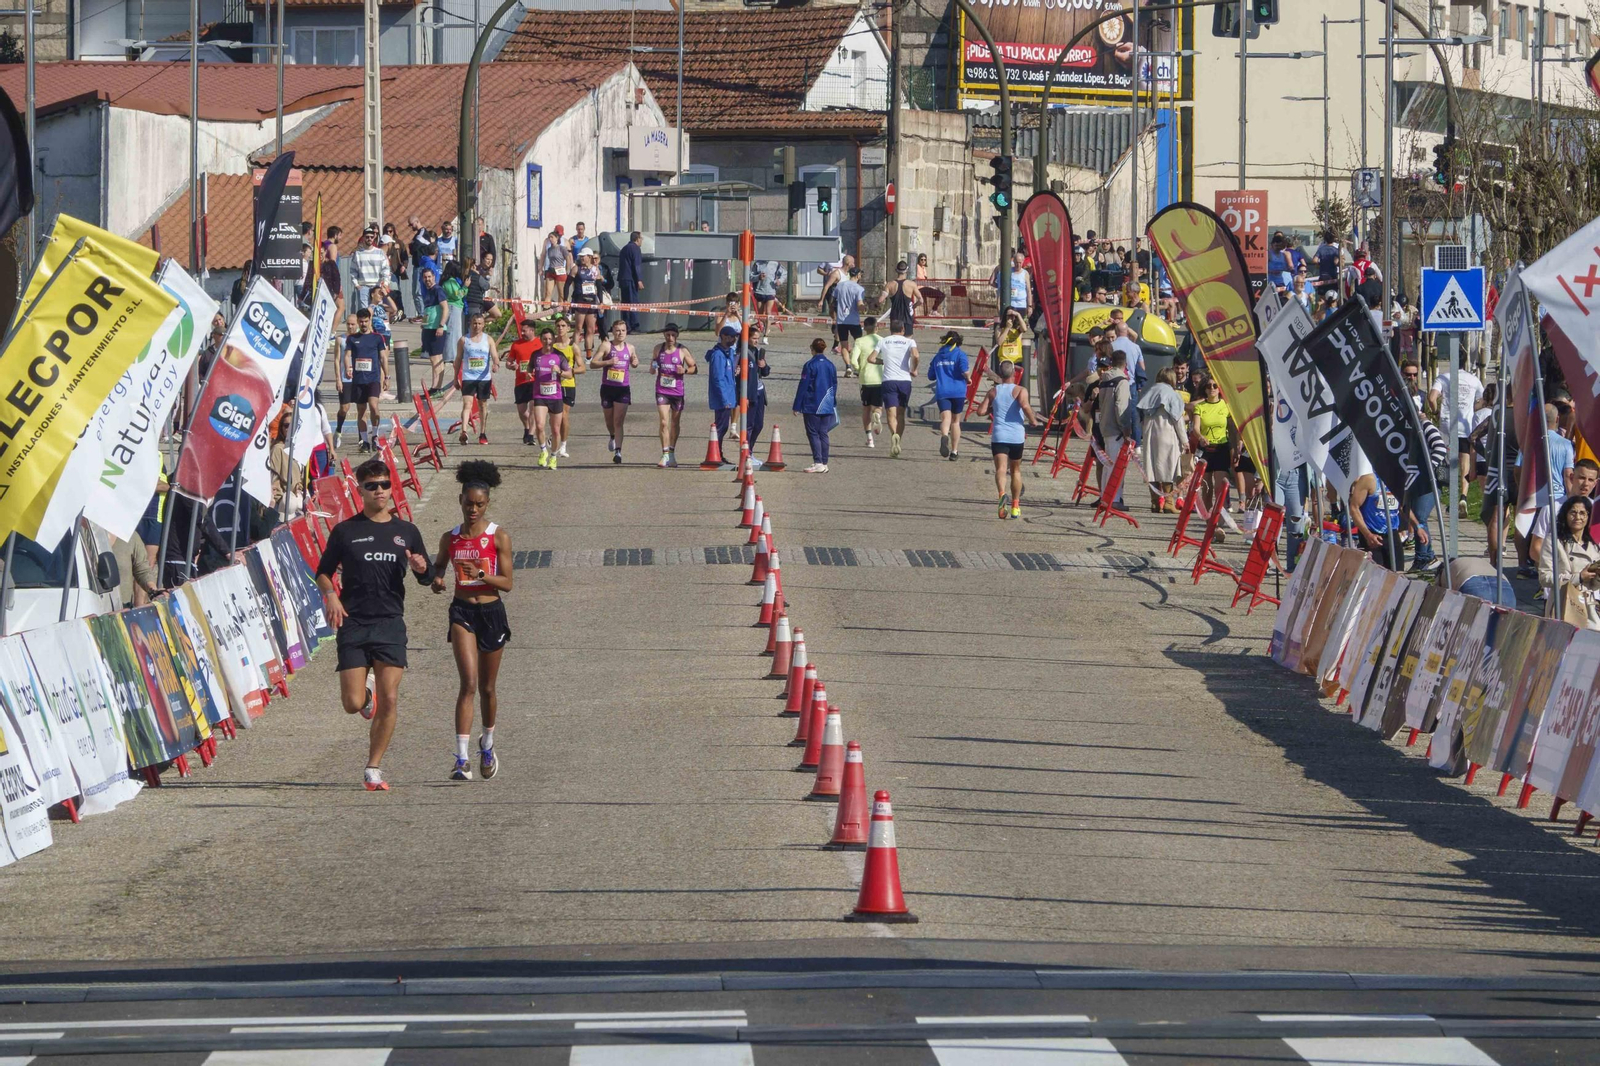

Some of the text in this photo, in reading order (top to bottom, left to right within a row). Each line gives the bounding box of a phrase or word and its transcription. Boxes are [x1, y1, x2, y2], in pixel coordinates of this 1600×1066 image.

[1005, 46, 1019, 59] TU
[1020, 46, 1046, 60] PACK
[973, 67, 988, 79] 986
[1005, 68, 1021, 81] 732
[1028, 70, 1045, 82] José
[1084, 72, 1107, 86] López,
[1108, 74, 1114, 83] 2
[1114, 74, 1131, 87] Bajo
[1221, 195, 1261, 205] oporriño
[248, 302, 285, 346] Giga
[1345, 318, 1365, 352] DACIA
[1506, 301, 1522, 342] Giga
[6, 402, 63, 478] INSTALACIONES
[60, 393, 69, 402] Y
[66, 314, 127, 395] MANTENIMIENTO
[126, 298, 143, 315] S.L.
[97, 369, 133, 441] energy
[1375, 373, 1413, 431] ALPINE
[218, 401, 253, 430] Giga
[364, 551, 397, 563] cam
